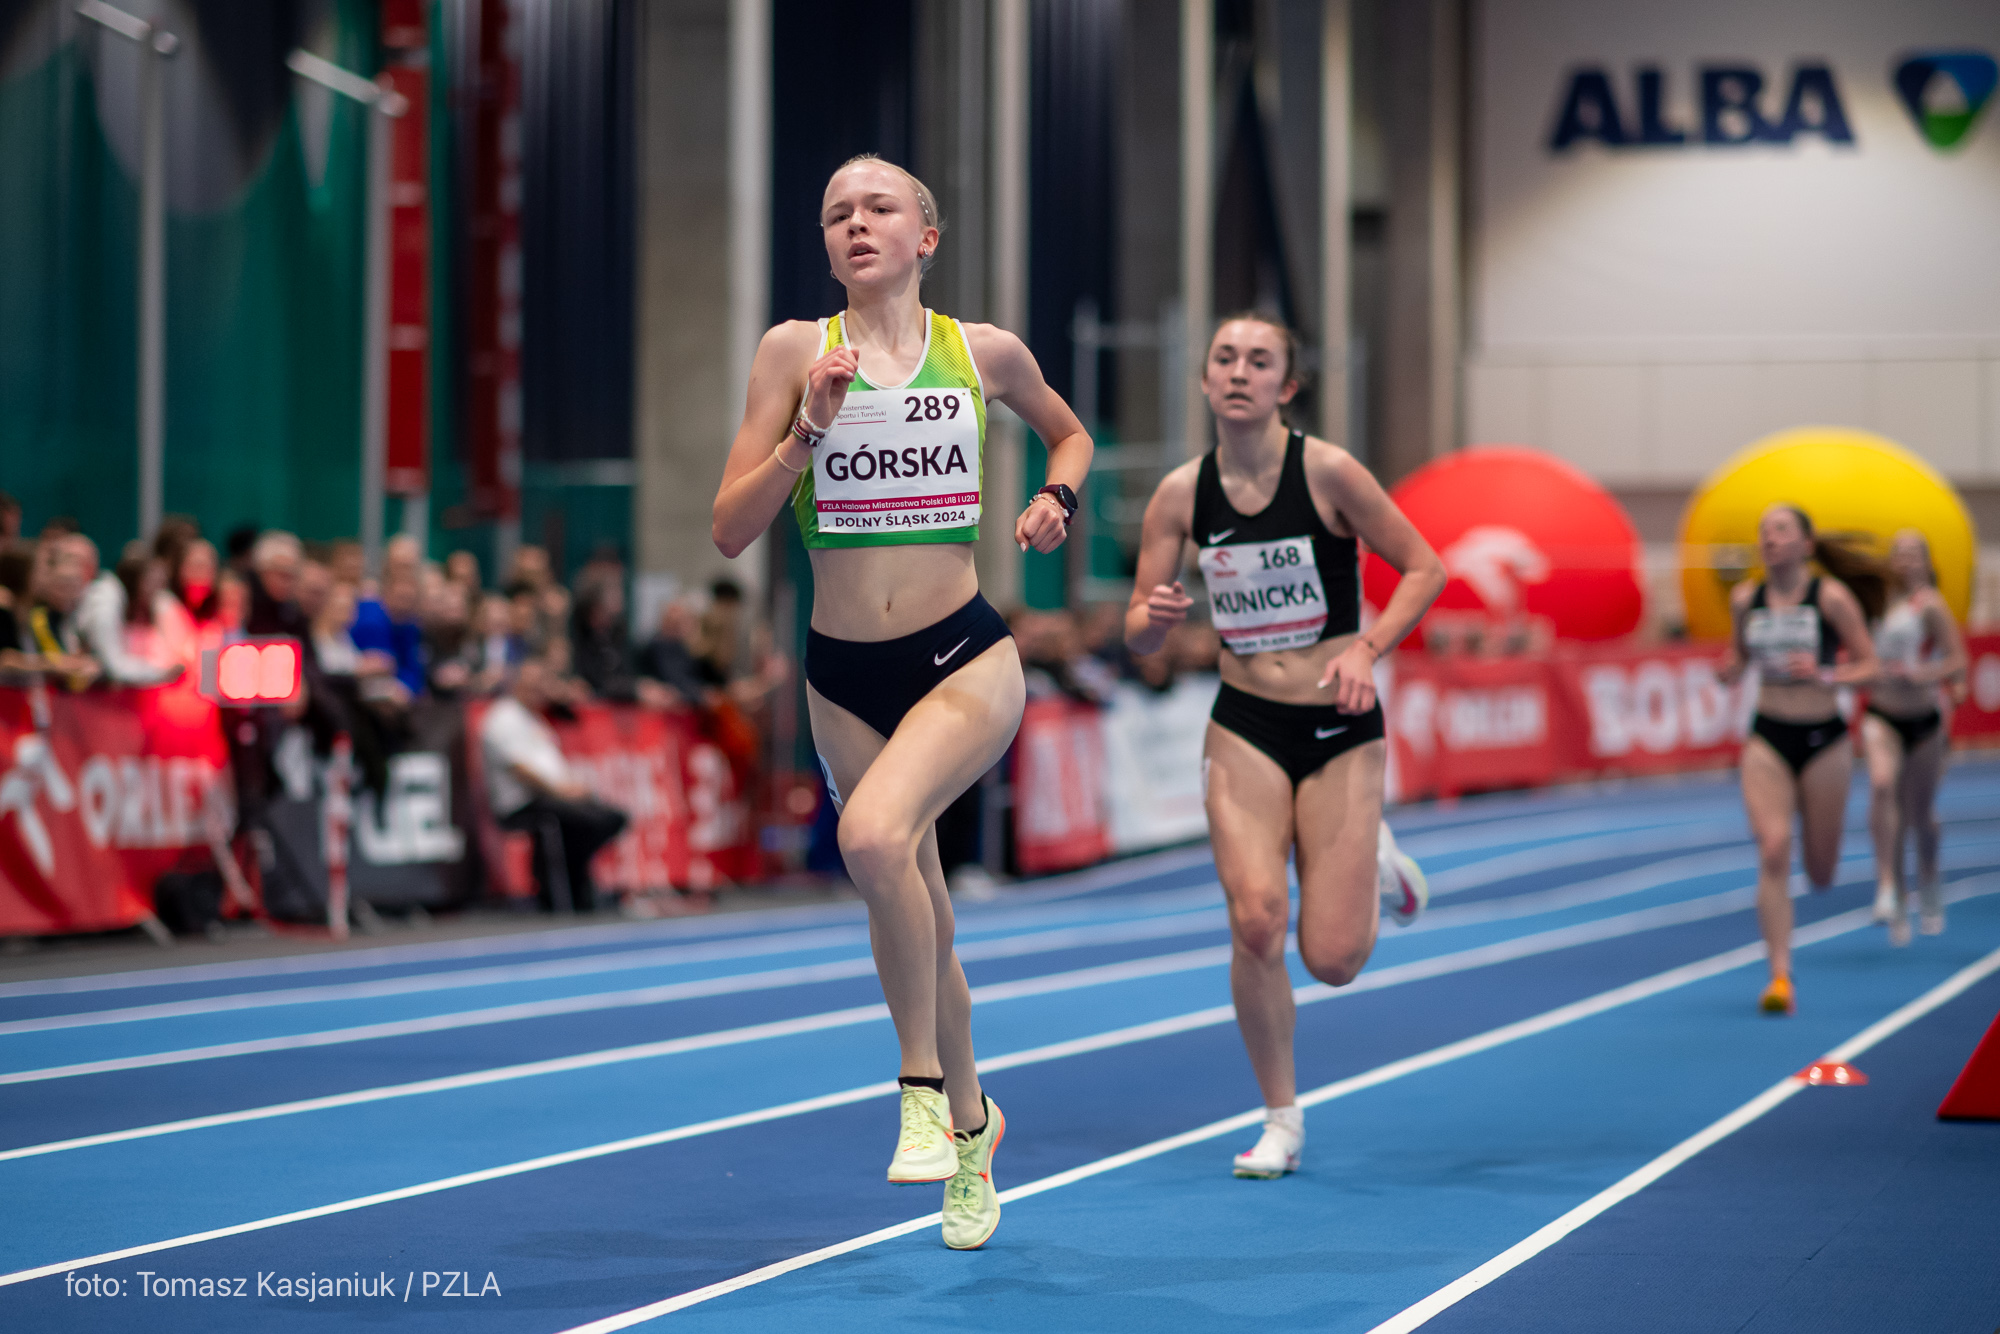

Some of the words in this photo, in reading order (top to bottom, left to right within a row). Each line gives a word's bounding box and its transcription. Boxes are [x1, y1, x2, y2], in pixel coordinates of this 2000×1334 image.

[1550, 64, 1857, 151] ALBA
[904, 394, 961, 423] 289
[825, 443, 969, 482] GÓRSKA
[822, 502, 841, 510] PZLA
[841, 502, 871, 510] Halowe
[871, 500, 920, 509] Mistrzostwa
[921, 497, 944, 507] Polski
[944, 496, 957, 504] U18
[961, 494, 976, 503] U20
[835, 516, 882, 528] DOLNY
[885, 513, 930, 528] ŚLĄSK
[933, 510, 966, 523] 2024
[1259, 546, 1301, 570] 168
[1212, 581, 1319, 614] KUNICKA
